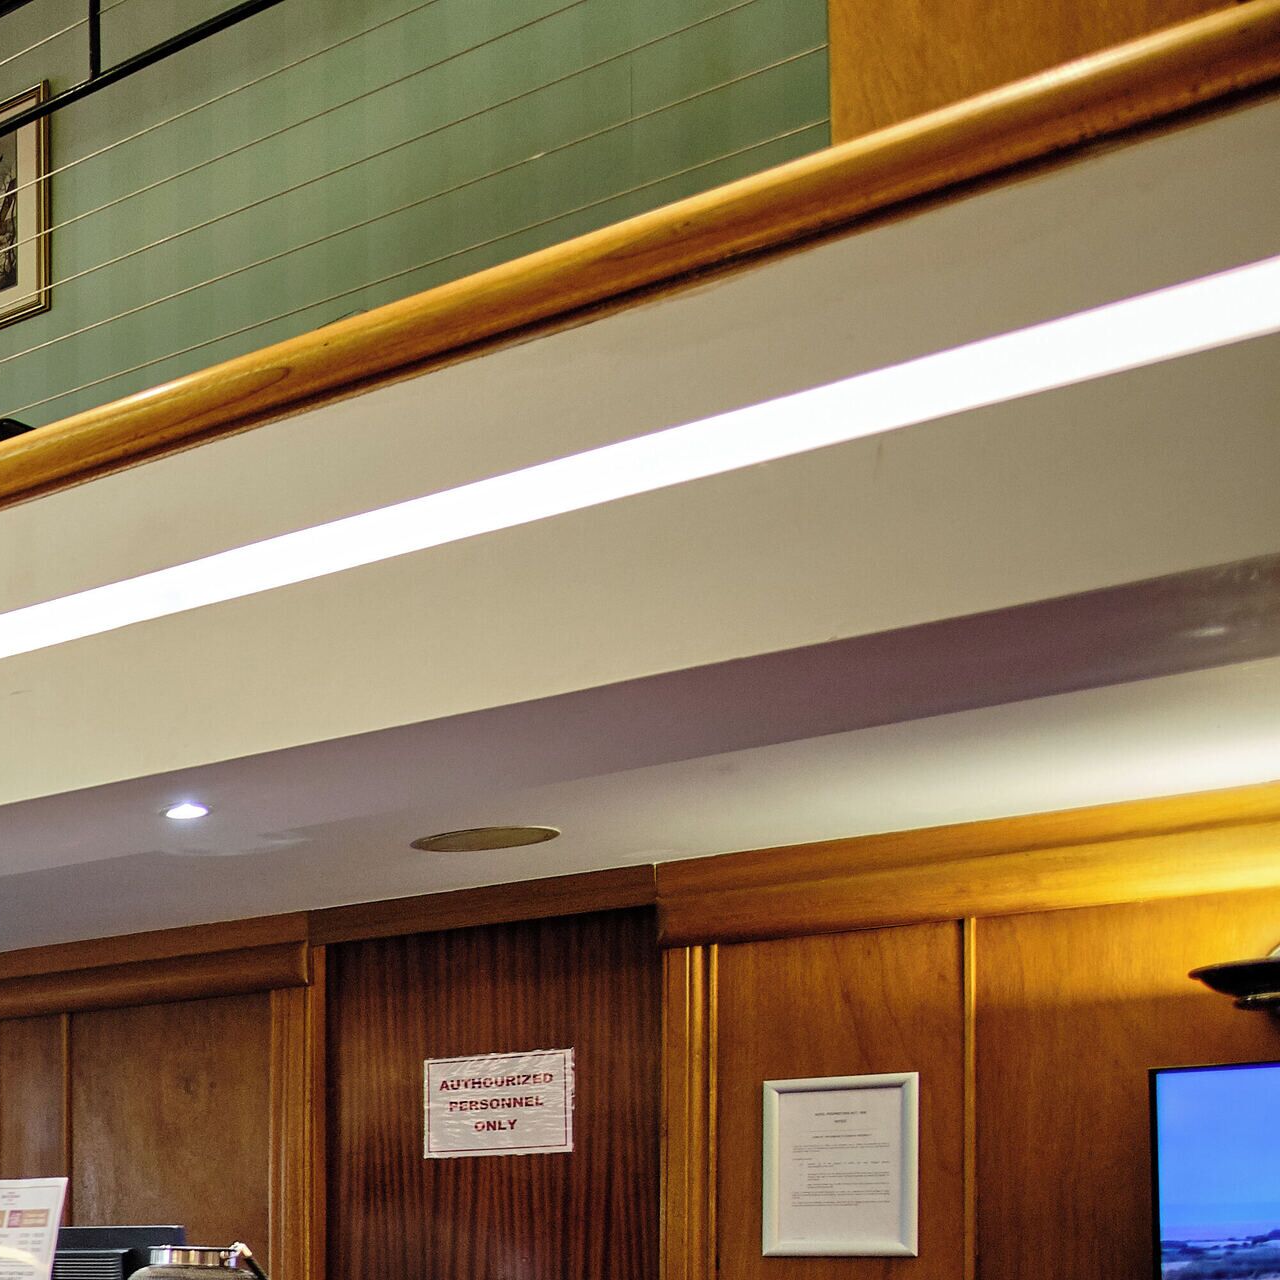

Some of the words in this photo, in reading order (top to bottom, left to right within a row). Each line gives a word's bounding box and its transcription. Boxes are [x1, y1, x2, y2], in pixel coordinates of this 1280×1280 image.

[439, 1072, 554, 1092] AUTHOURIZED
[448, 1096, 544, 1112] PERSONNEL
[474, 1118, 518, 1132] ONLY
